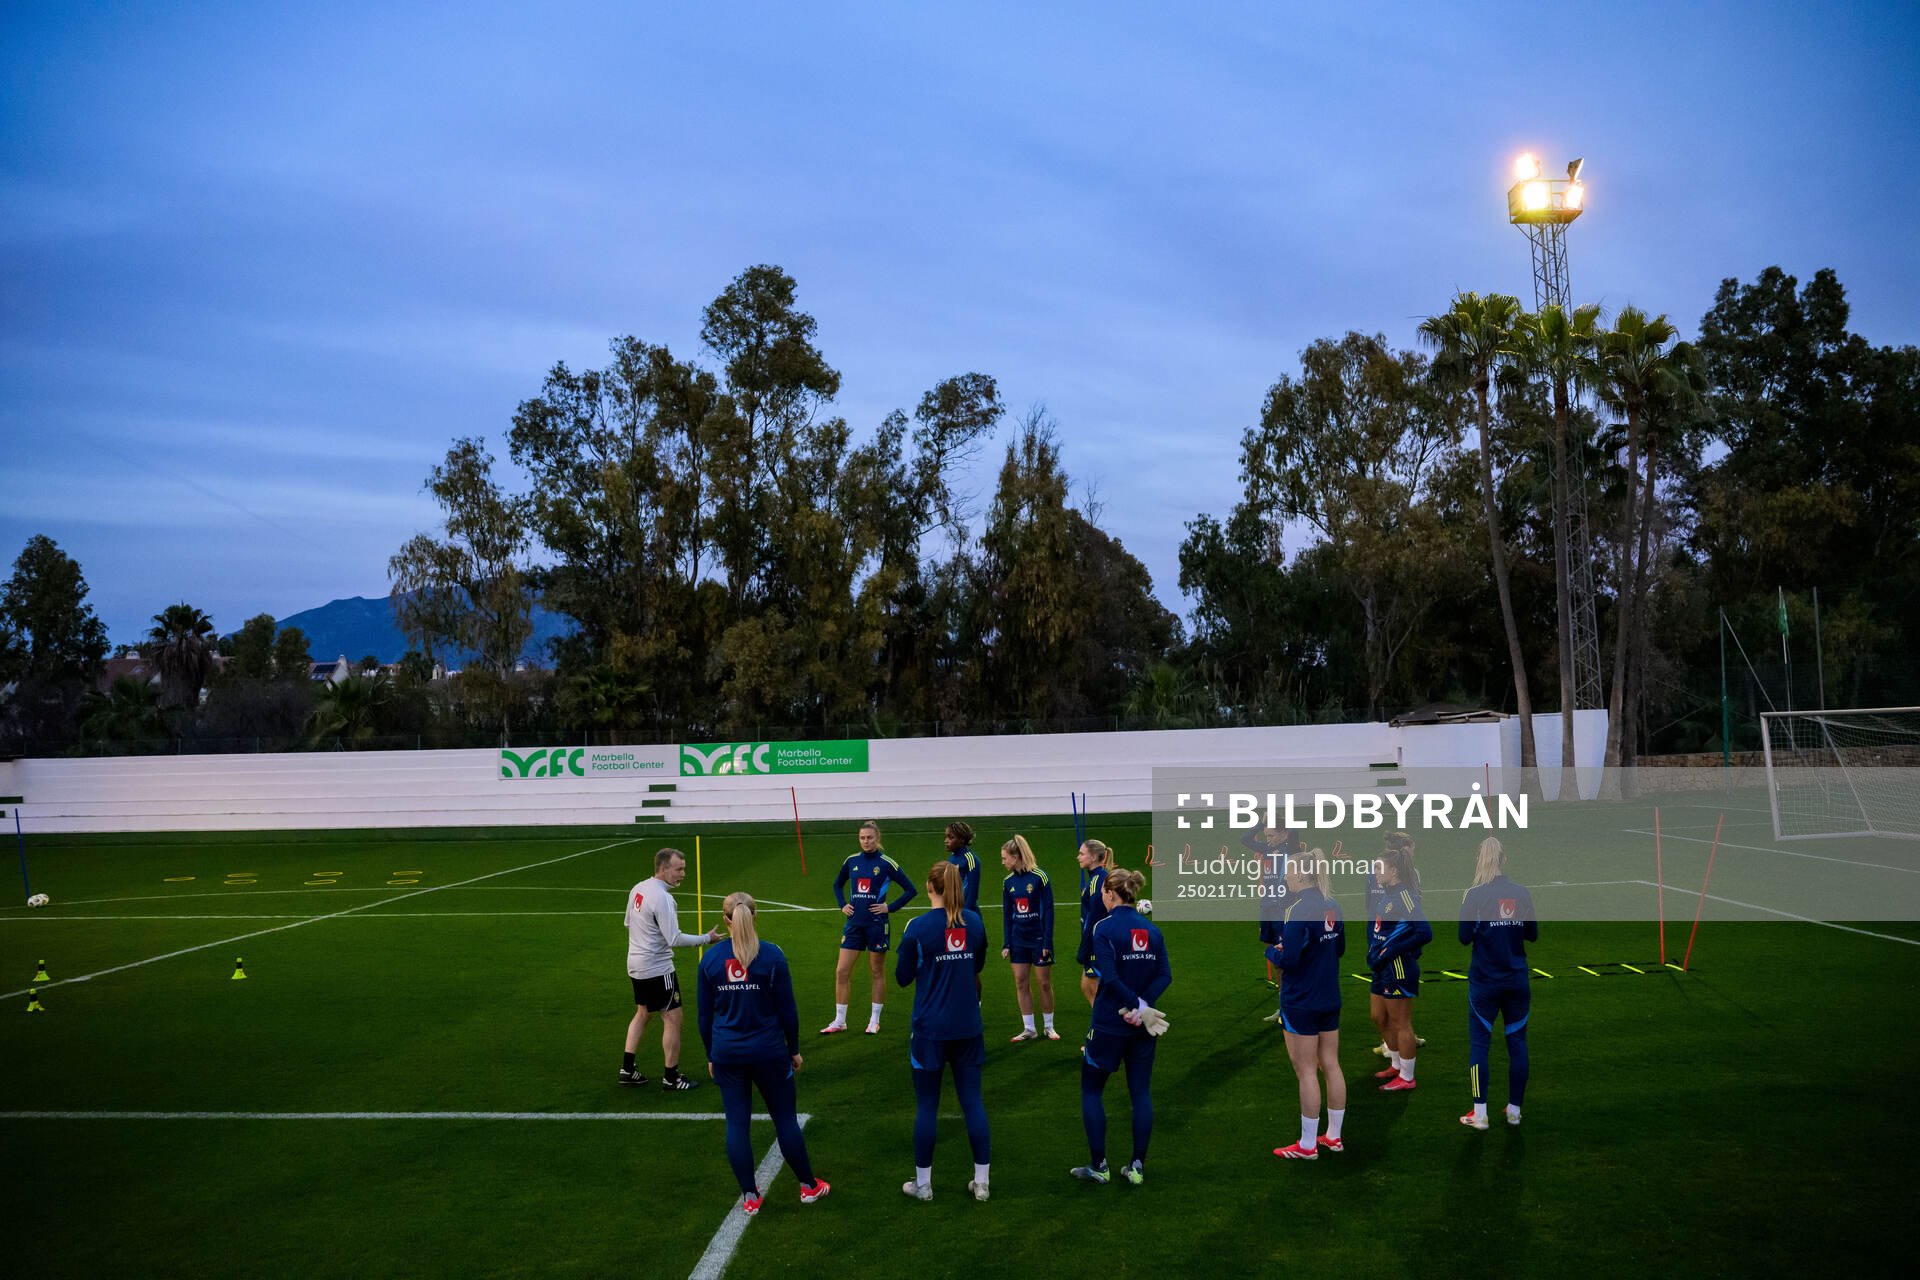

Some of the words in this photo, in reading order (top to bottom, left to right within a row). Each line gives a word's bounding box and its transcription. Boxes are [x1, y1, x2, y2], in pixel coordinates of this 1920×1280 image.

[591, 752, 634, 762] Marbella
[777, 748, 821, 758] Marbella
[591, 762, 630, 771] Football
[632, 761, 665, 769] Center
[777, 757, 817, 767] Football
[819, 756, 853, 766] Center
[717, 984, 745, 992] SVENSKA
